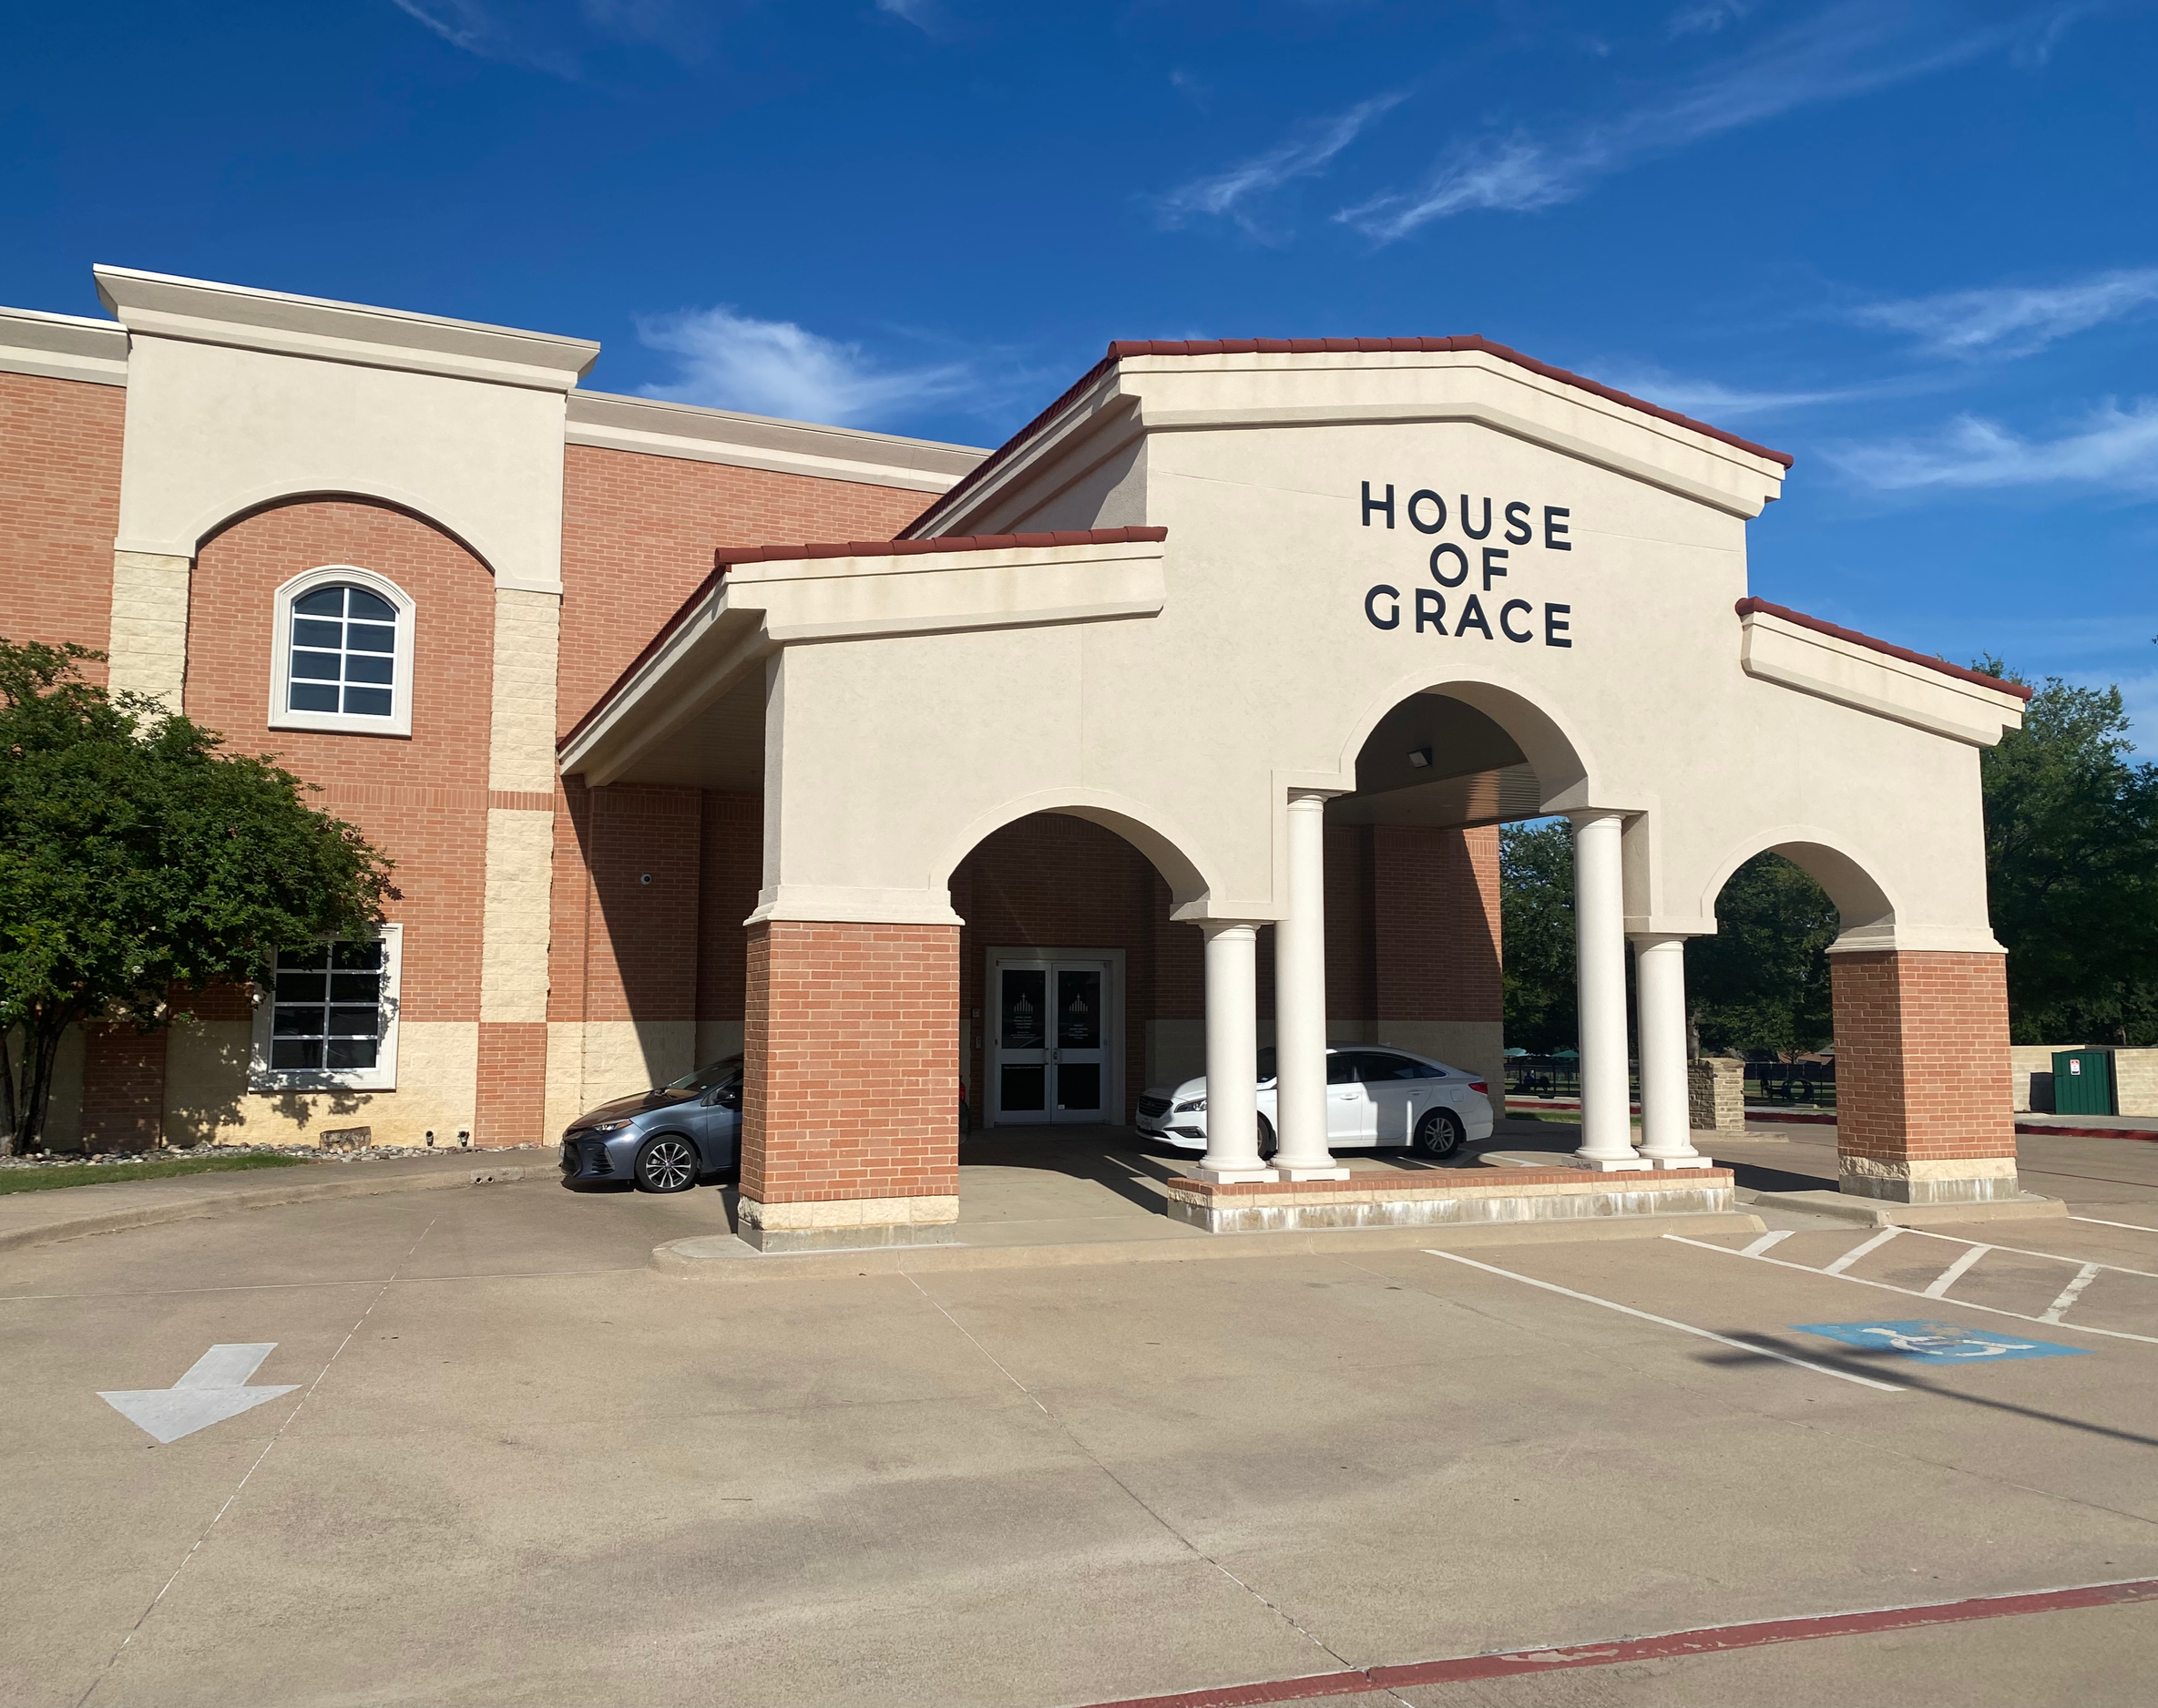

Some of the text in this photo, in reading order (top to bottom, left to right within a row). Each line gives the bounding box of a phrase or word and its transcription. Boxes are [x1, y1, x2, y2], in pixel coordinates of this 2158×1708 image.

[1361, 480, 1572, 551] HOUSE
[1429, 542, 1509, 592] OF
[1365, 584, 1572, 649] GRACE
